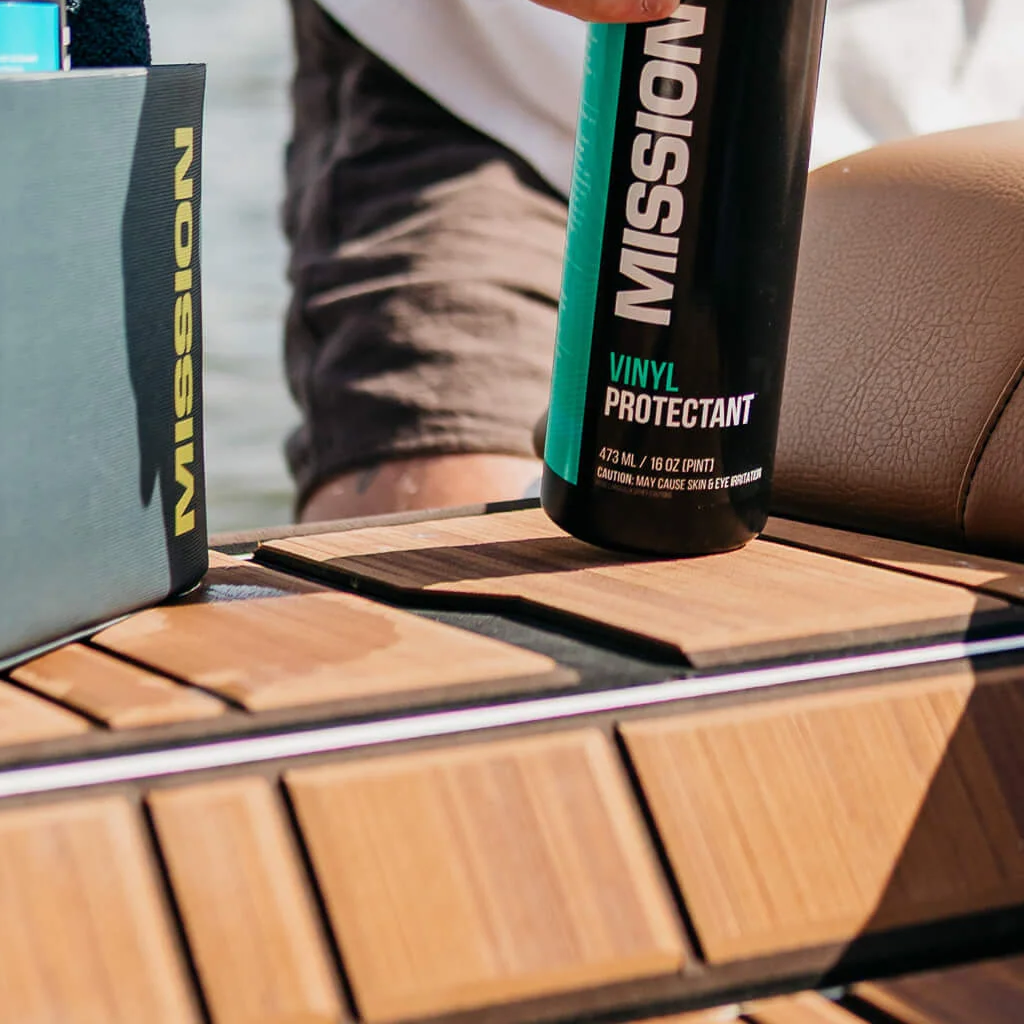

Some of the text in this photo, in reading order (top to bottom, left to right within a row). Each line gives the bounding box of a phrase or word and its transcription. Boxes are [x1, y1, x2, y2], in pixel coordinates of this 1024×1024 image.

[614, 3, 706, 326] MISSION
[174, 127, 195, 536] MISSION
[610, 352, 679, 392] VINYL
[604, 386, 755, 429] PROTECTANT
[597, 466, 635, 485] CAUTION:
[636, 475, 656, 488] MAY
[657, 478, 686, 490] CAUSE
[687, 479, 707, 491] SKIN
[707, 478, 714, 490] &
[715, 476, 730, 489] EYE
[599, 446, 619, 464] 473
[621, 451, 636, 468] ML
[639, 455, 648, 468] /
[650, 457, 663, 471] 16
[665, 457, 680, 472] OZ
